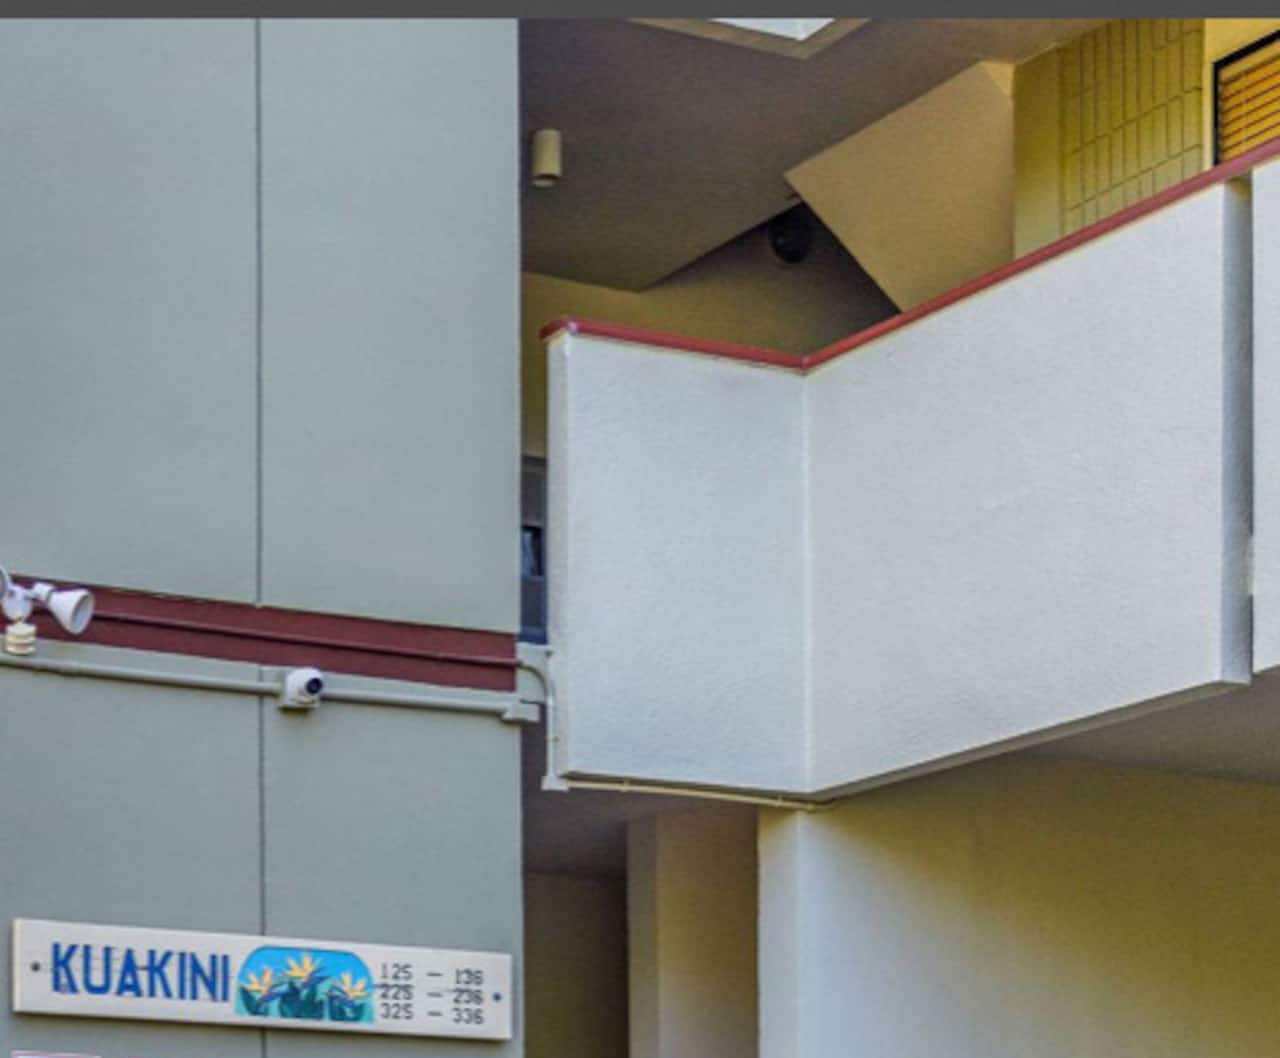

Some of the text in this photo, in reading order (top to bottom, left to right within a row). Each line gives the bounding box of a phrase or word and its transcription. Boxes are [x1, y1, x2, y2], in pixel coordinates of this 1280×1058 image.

[52, 941, 231, 1002] KUAKINI
[381, 962, 414, 981] 125
[380, 982, 414, 1001] 225
[380, 1002, 414, 1020] 325
